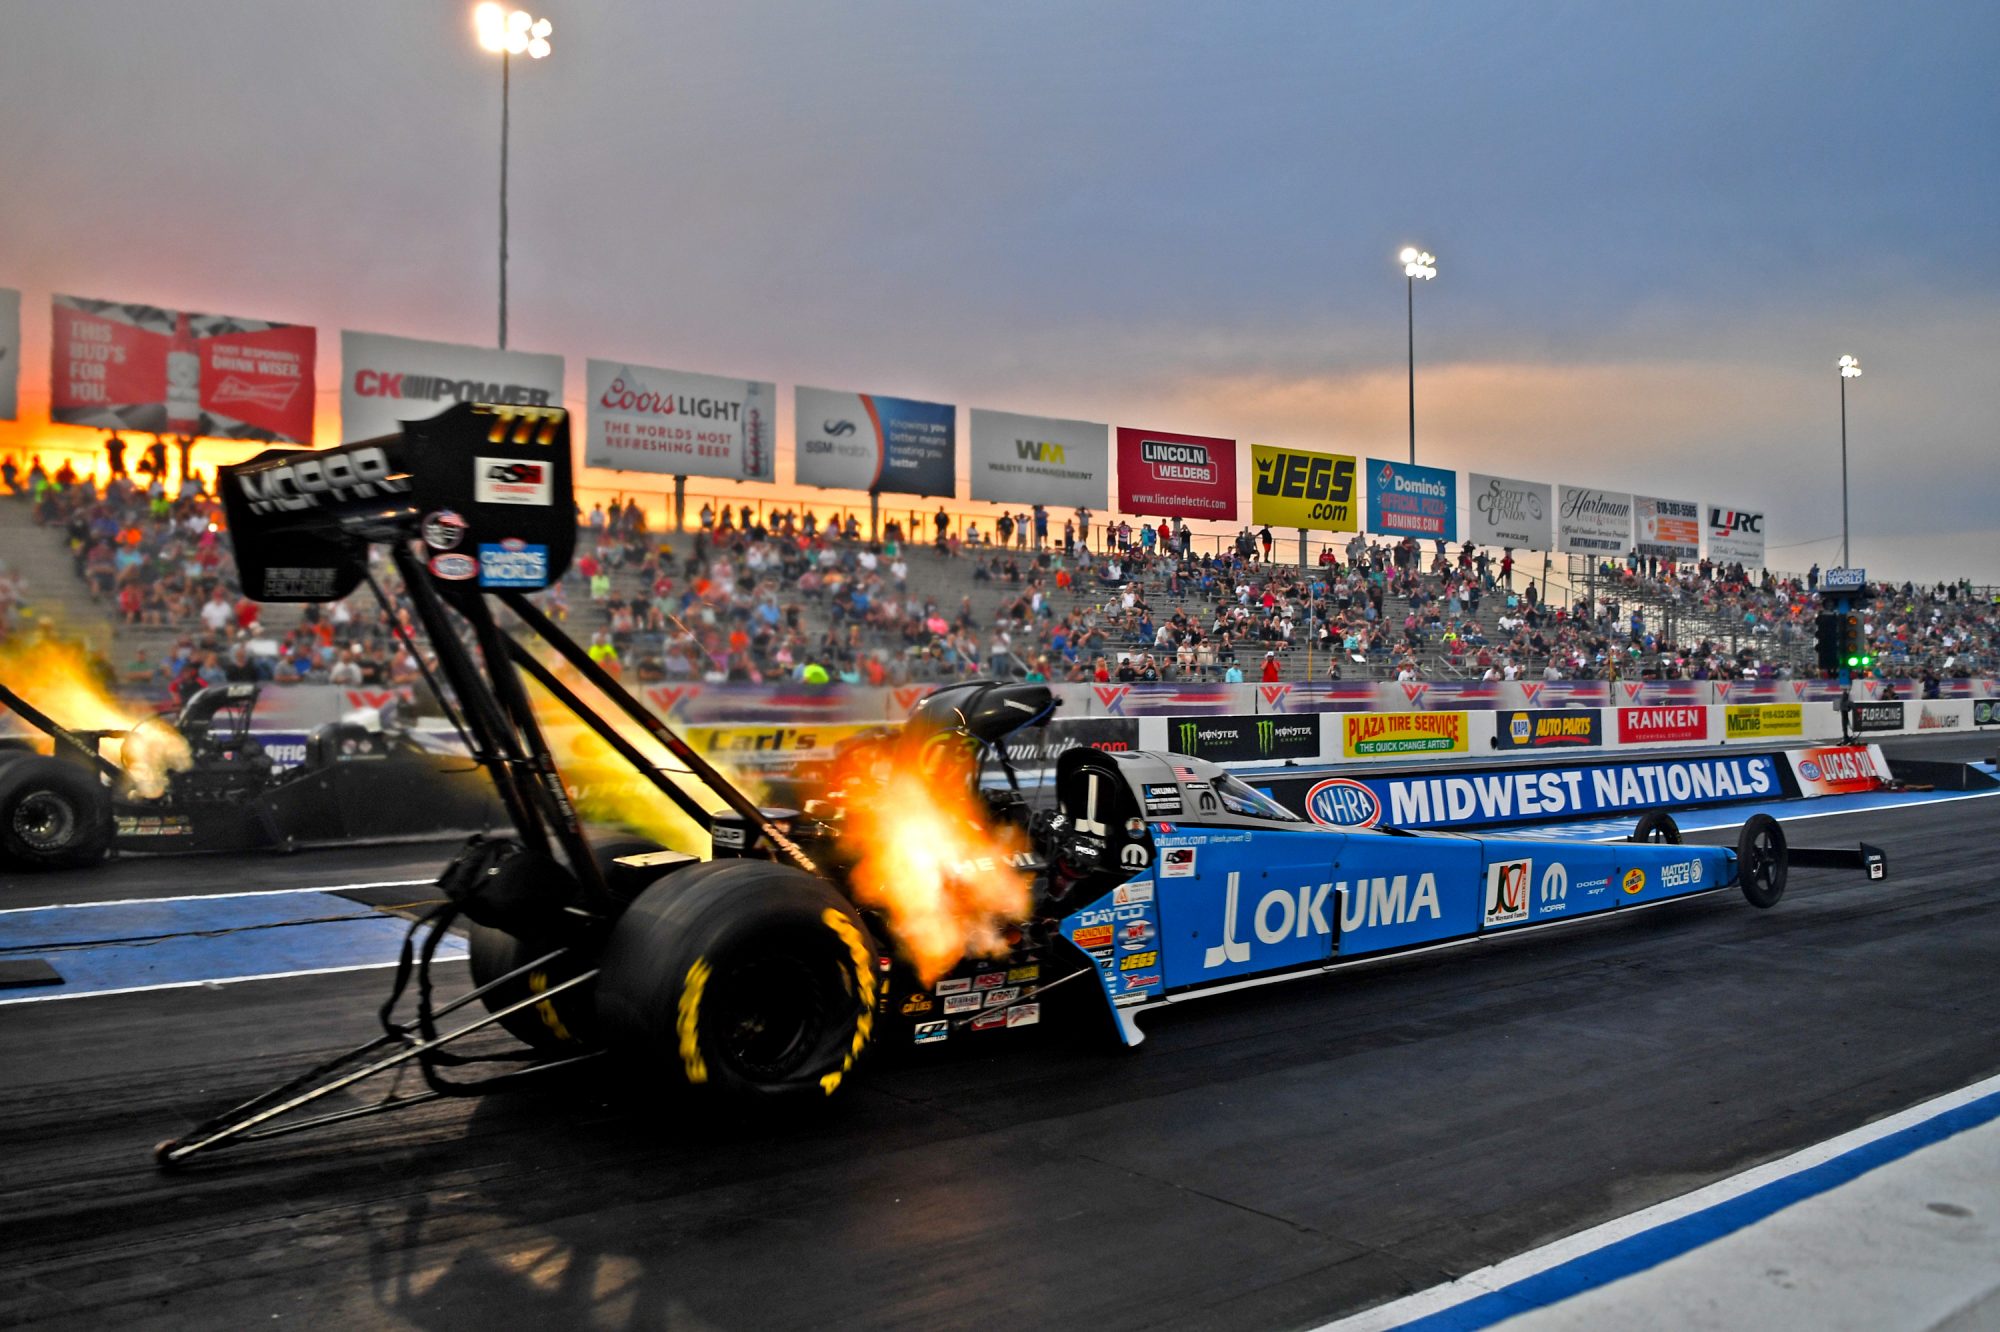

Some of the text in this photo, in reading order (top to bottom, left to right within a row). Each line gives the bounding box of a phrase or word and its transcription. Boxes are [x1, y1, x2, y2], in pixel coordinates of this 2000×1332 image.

[71, 321, 112, 342] THIS
[70, 341, 126, 364] BUD'S
[70, 361, 106, 380] FOR
[212, 354, 254, 373] DRINK
[70, 381, 112, 402] YOU.
[354, 369, 404, 399] CK
[602, 378, 741, 422] Coors LIGHT
[604, 421, 732, 443] THE WORLDS MOST
[889, 420, 947, 434] Knowing you
[606, 436, 730, 458] REFRESHING BEER
[890, 433, 947, 446] better means
[890, 445, 943, 459] treating you
[1015, 439, 1065, 465] WM
[1145, 444, 1205, 465] LINCOLN
[890, 458, 919, 469] better.
[988, 462, 1093, 481] WASTE MANAGEMENT
[1159, 465, 1210, 481] WELDERS
[1257, 454, 1355, 502] JEGS
[1395, 476, 1446, 497] Domino's
[1490, 480, 1525, 500] SCOTT
[1132, 493, 1227, 510] www.lincolnelectric.com
[1381, 493, 1445, 515] OFFICIAL PIZZA
[1477, 494, 1520, 512] CREDIT
[1561, 489, 1629, 519] Hartmann
[1307, 503, 1347, 521] .com
[1488, 507, 1526, 526] UNION
[1388, 513, 1439, 532] DOMINOS.COM
[482, 563, 547, 579] WORLD
[1827, 576, 1863, 584] WORLD
[1513, 721, 1529, 735] NAPA
[1536, 717, 1591, 736] AUTO PARTS
[1628, 710, 1698, 729] RANKEN
[1728, 714, 1760, 731] Munie
[1198, 730, 1239, 740] MONSTER
[1275, 726, 1312, 736] MONSTER
[1348, 715, 1459, 746] PLAZA TIRE SERVICE
[1360, 739, 1450, 752] THE QUICK CHANGE ARTIST
[1818, 751, 1877, 781] LUCAS OIL
[1316, 759, 1771, 825] NHRA MIDWEST NATIONALS
[1154, 835, 1207, 846] okuma.com
[1662, 863, 1690, 876] MATCO
[1576, 879, 1608, 888] DODGE
[1662, 872, 1690, 887] TOOLS
[1079, 904, 1147, 926] DAYCO
[1540, 903, 1566, 913] MOPAR
[1074, 926, 1112, 939] SANDVIK
[1120, 951, 1158, 970] JEGS
